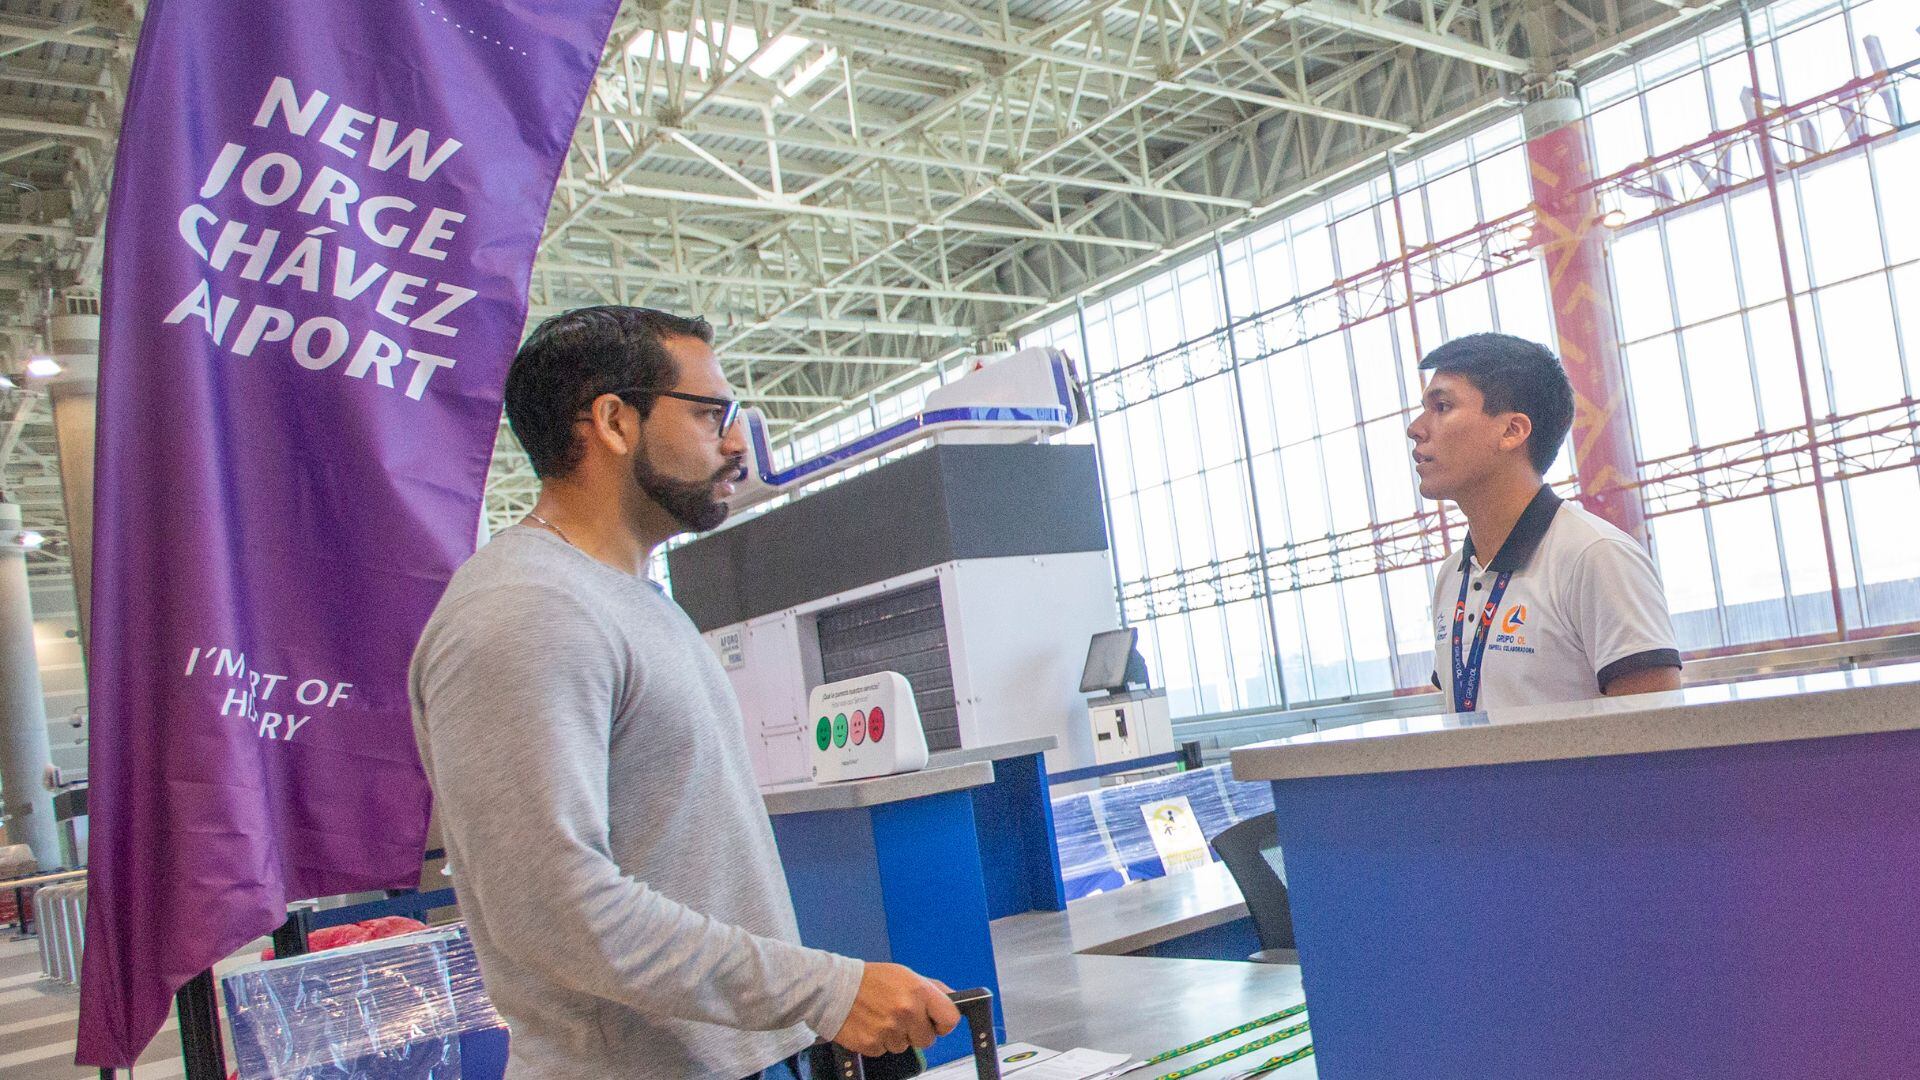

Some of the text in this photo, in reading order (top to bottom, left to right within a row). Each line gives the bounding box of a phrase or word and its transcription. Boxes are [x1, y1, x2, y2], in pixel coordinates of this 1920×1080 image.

[252, 75, 463, 182] NEW
[200, 141, 467, 261] JORGE
[177, 203, 479, 338] CHÁVEZ
[162, 278, 457, 401] AIPORT
[184, 646, 246, 679] I'M
[296, 678, 354, 708] OF
